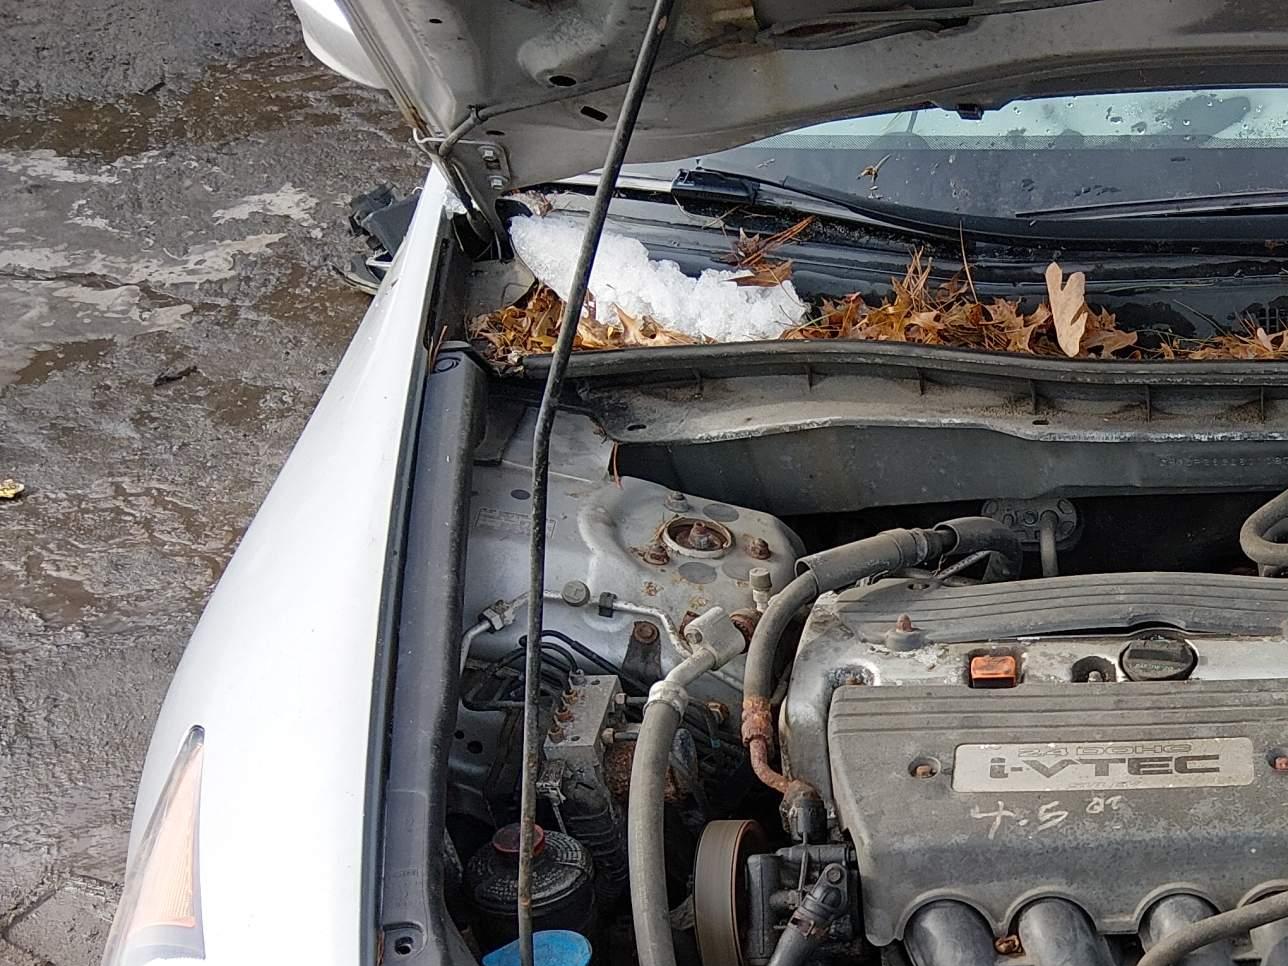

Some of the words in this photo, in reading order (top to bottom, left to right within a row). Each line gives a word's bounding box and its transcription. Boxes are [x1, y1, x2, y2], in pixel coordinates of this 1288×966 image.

[1018, 746, 1068, 758] 2.4
[1078, 743, 1192, 755] DOHC
[989, 754, 1220, 779] i-VTEC
